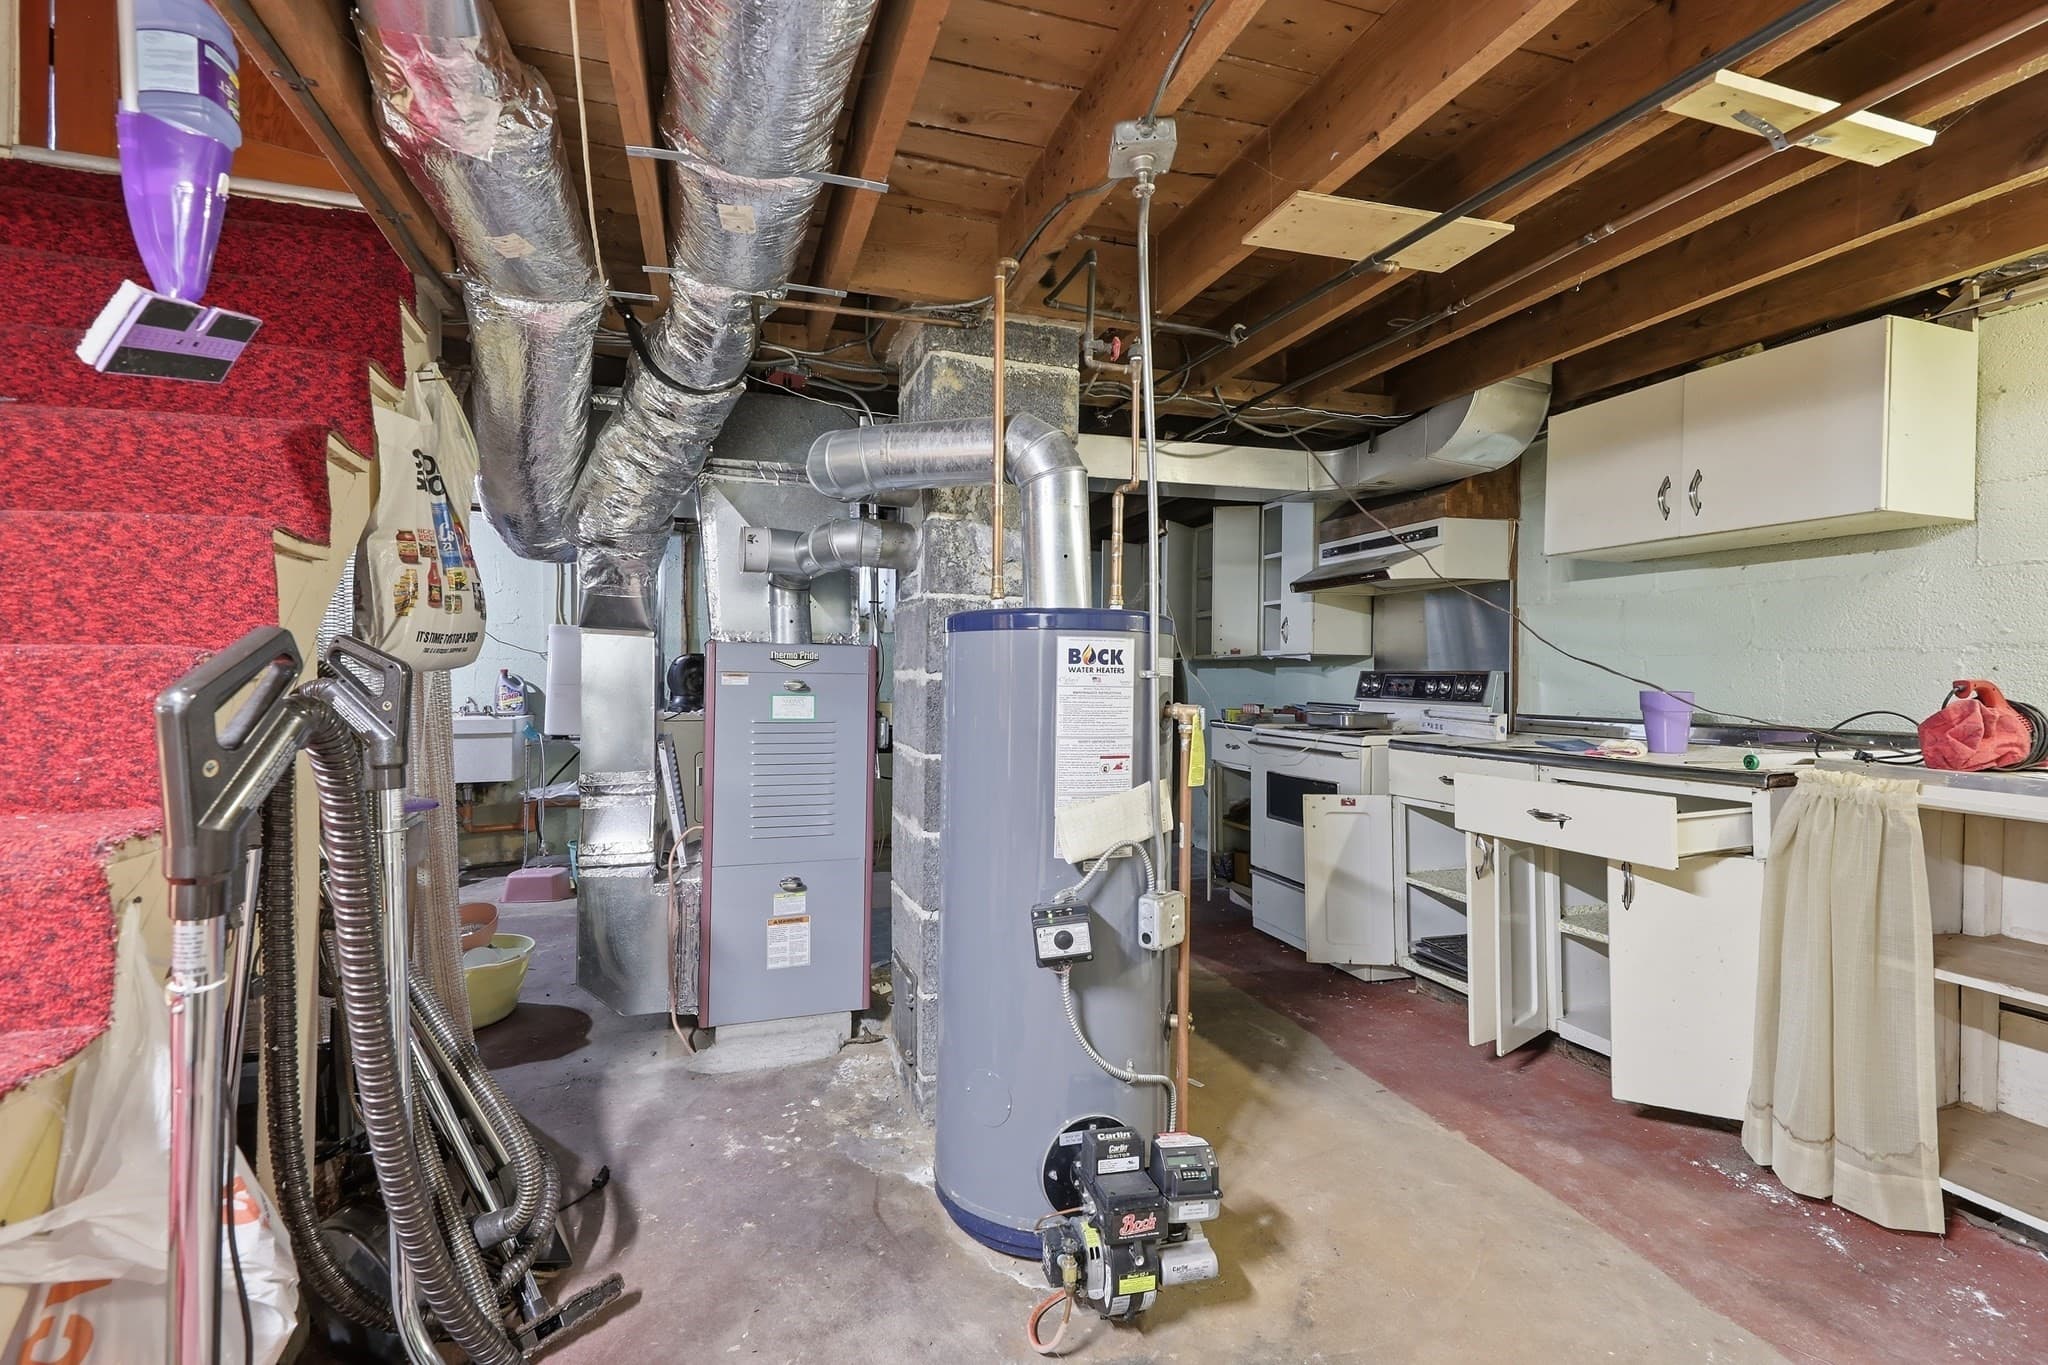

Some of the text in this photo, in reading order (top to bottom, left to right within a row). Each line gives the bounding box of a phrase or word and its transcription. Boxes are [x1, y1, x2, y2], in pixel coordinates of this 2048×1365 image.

[771, 650, 819, 660] Thermo Pride
[1068, 666, 1125, 674] WATER HEATERS
[1097, 1131, 1131, 1141] Carlin
